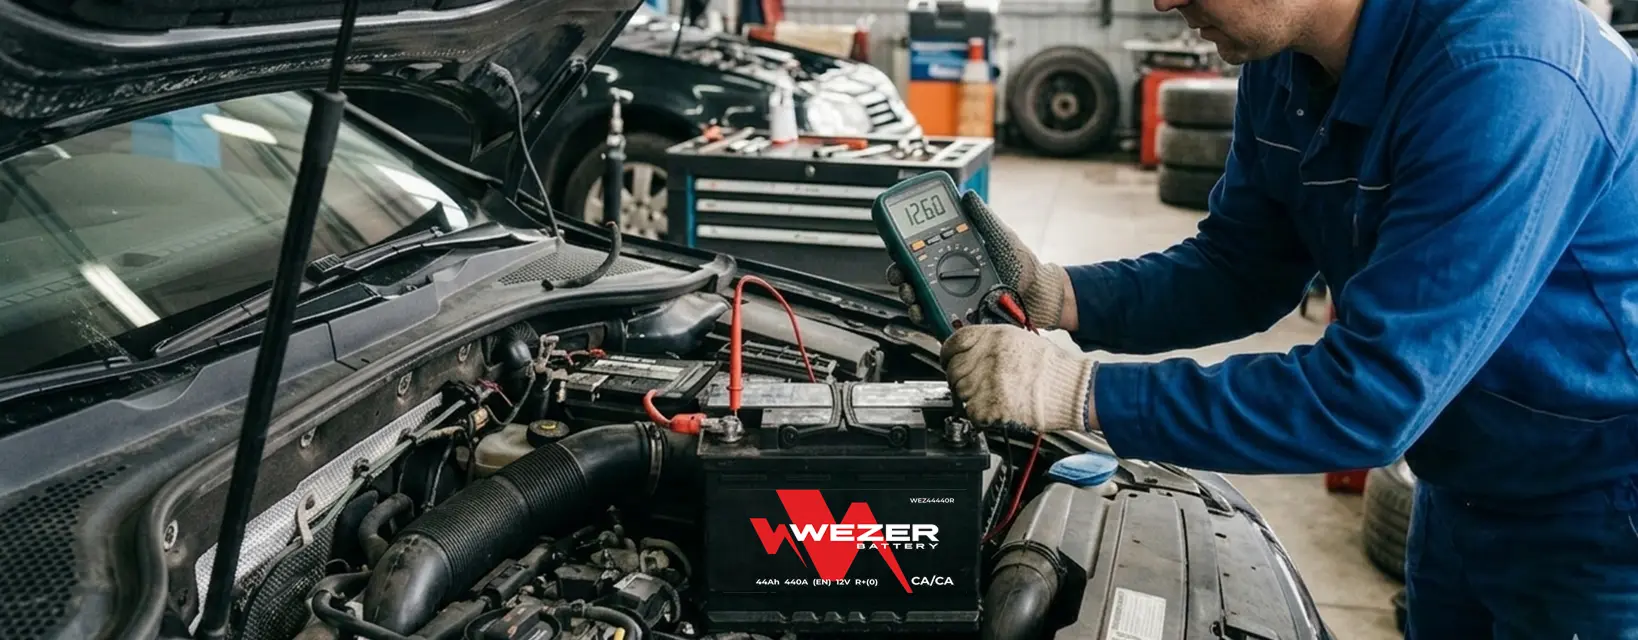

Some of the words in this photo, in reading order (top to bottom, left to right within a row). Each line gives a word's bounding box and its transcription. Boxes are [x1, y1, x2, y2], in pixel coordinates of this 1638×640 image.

[789, 524, 940, 541] WEZER
[755, 578, 780, 586] 44Ah
[784, 578, 809, 586] 440A
[812, 578, 832, 587] (EN)
[836, 578, 851, 586] 12V
[911, 576, 955, 587] CA/CA
